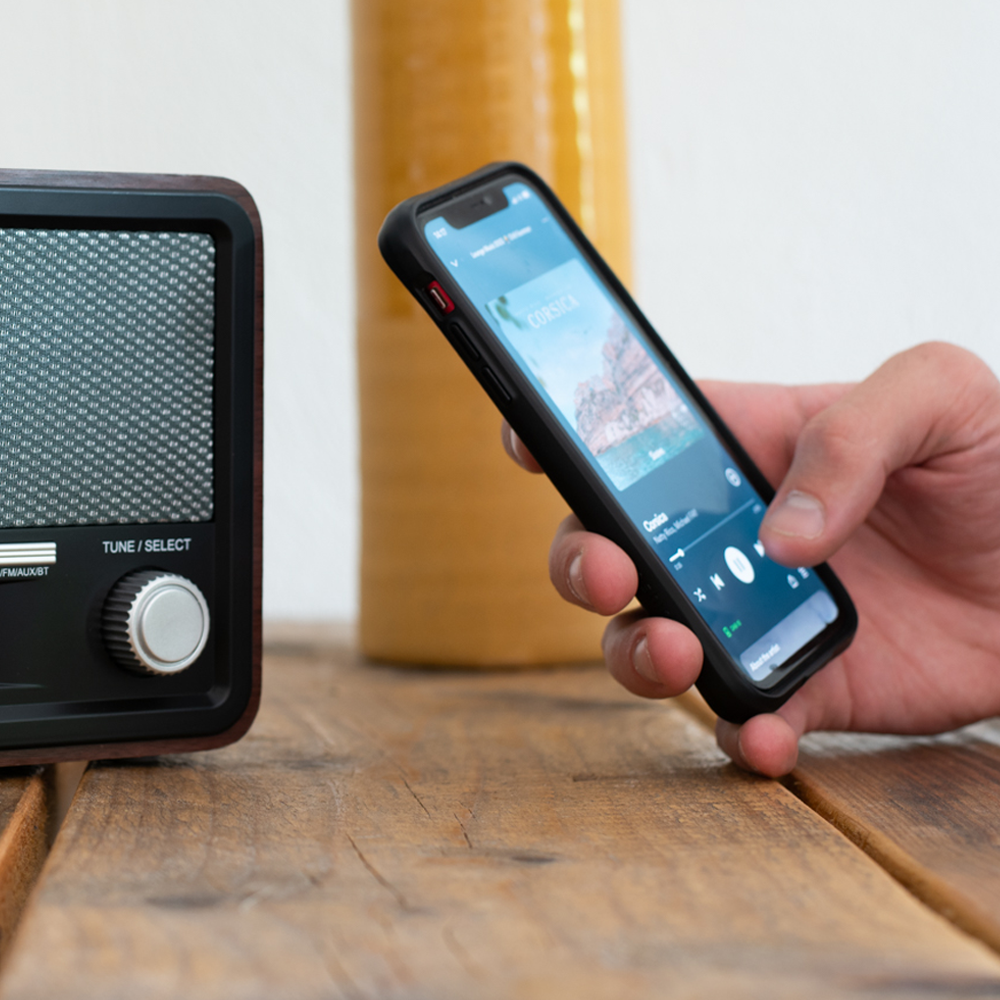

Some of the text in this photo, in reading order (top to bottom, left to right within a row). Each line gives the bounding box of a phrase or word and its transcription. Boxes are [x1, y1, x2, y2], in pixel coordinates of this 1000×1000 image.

[527, 294, 581, 329] CORSICA
[643, 512, 669, 532] Corsica
[102, 538, 191, 554] TUNE / SELECT
